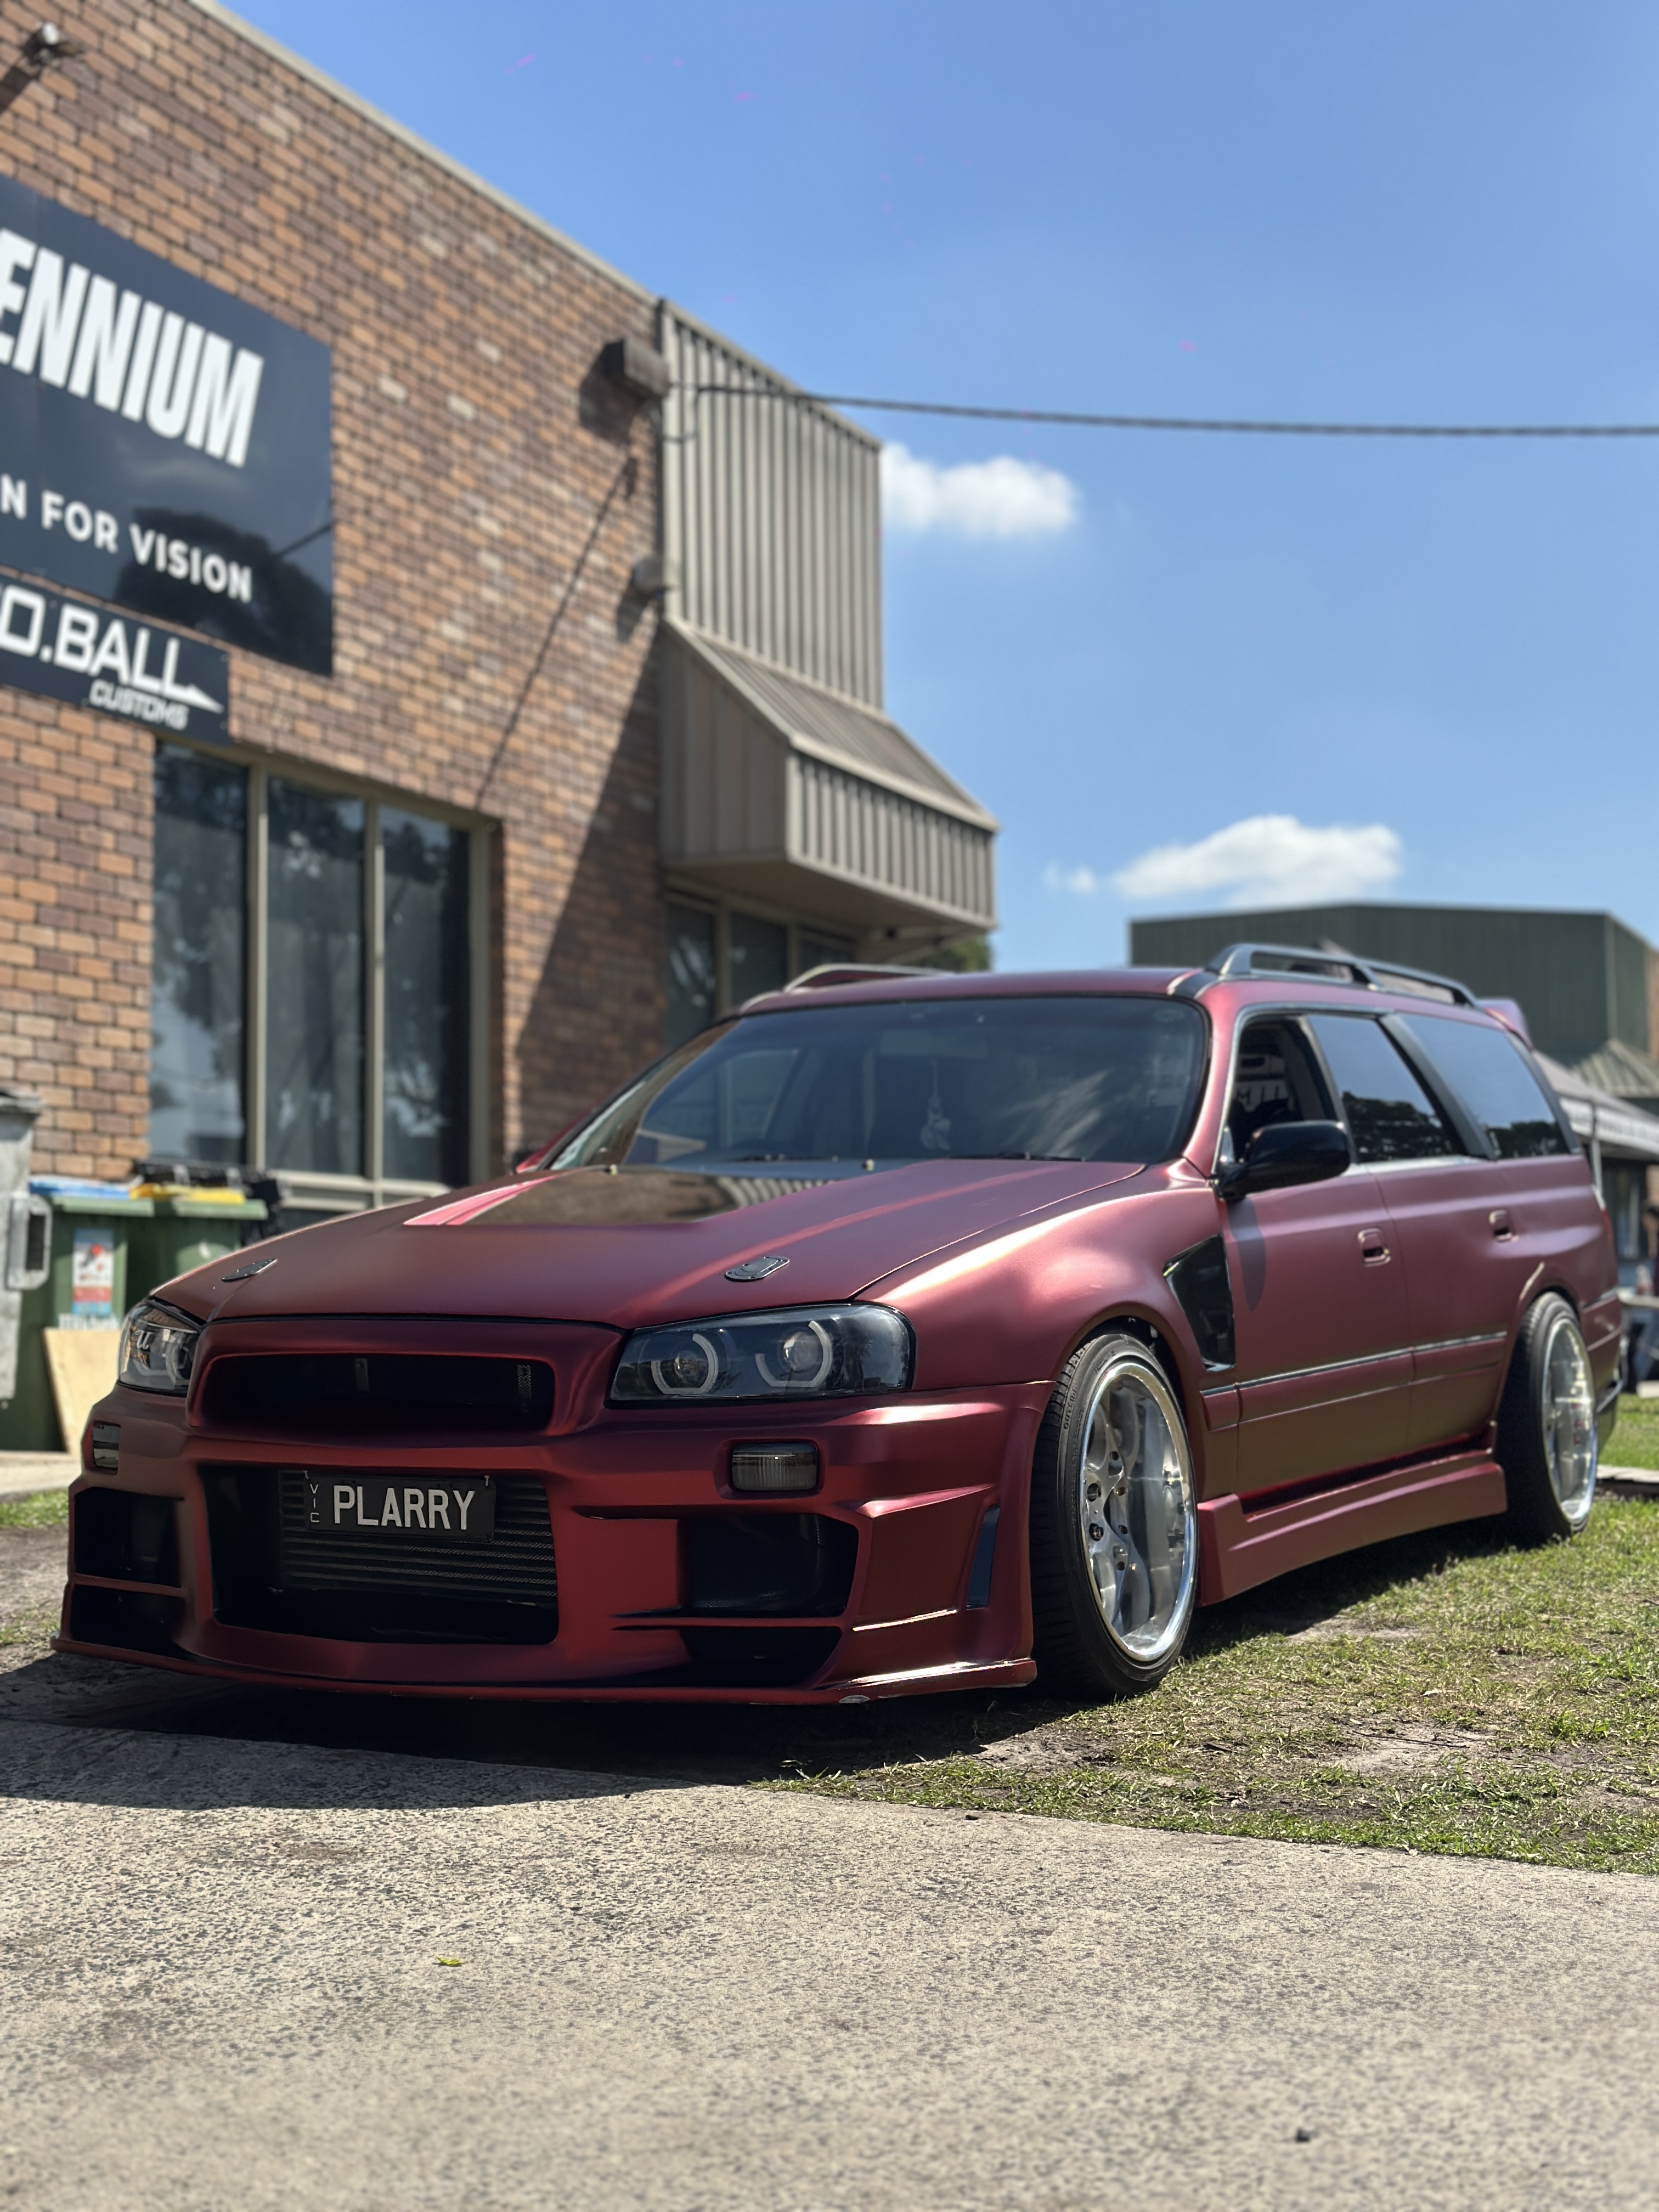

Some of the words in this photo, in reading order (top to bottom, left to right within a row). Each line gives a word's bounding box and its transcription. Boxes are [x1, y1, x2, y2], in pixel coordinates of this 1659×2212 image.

[0, 227, 264, 469] ENNIUM
[1, 473, 27, 520] N
[41, 489, 119, 554] FOR
[129, 522, 252, 603] VISION
[0, 584, 224, 713] O.BALL
[89, 678, 190, 731] CUSTOMS
[333, 1485, 476, 1530] PLARRY
